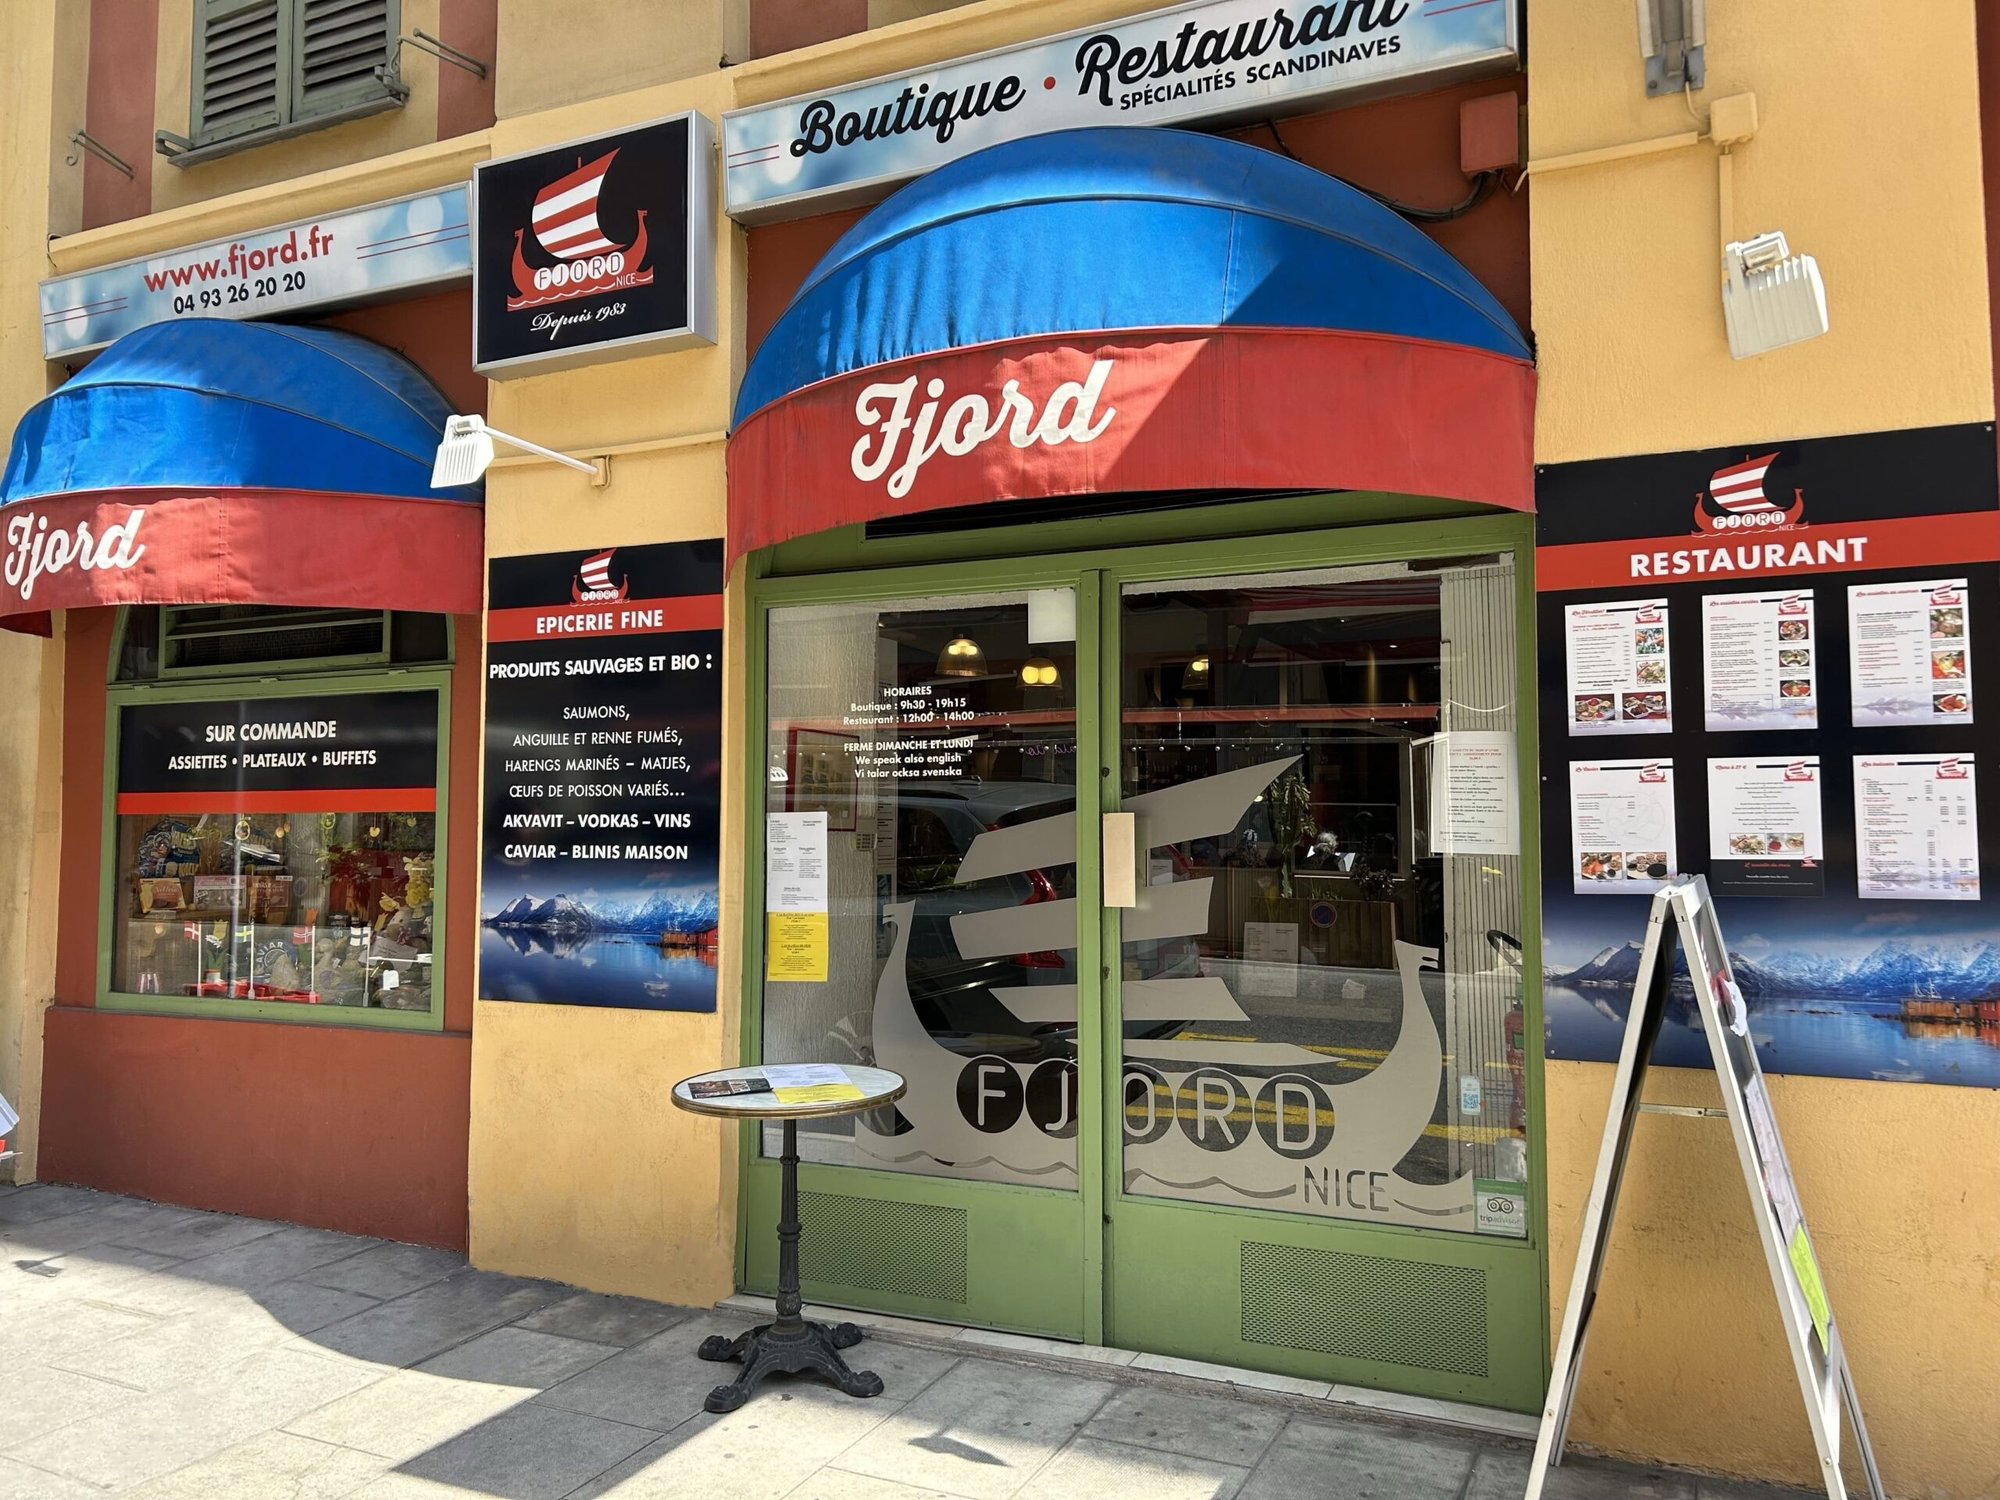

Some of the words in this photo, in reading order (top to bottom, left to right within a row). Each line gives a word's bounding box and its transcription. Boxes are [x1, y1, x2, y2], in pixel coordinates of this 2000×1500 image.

[1119, 68, 1236, 110] SPÉCIALITÉS
[1246, 35, 1401, 84] SCANDINAVES
[789, 75, 1027, 157] Boutique
[143, 224, 334, 293] www.fjord.fr
[536, 253, 623, 290] FJORD
[615, 272, 637, 287] NICE
[173, 294, 195, 315] 04
[200, 288, 222, 308] 93
[227, 283, 249, 304] 26
[254, 276, 277, 299] 20
[282, 271, 306, 292] 20
[530, 309, 593, 341] Depuis
[596, 302, 627, 321] 1983
[851, 359, 1117, 499] Fjord
[1714, 511, 1784, 529] FJORD
[4, 508, 148, 601] Fjord
[1630, 536, 1868, 578] RESTAURANT
[536, 612, 613, 634] EPICERIE
[621, 609, 664, 628] FINE
[489, 660, 560, 679] PRODUITS
[565, 656, 643, 676] SAUVAGES
[649, 655, 666, 671] ET
[671, 653, 700, 670] BIO
[883, 685, 932, 697] HORAIRES
[563, 705, 631, 721] SAUMONS,
[850, 700, 892, 714] Boutique
[900, 699, 926, 710] 9h30
[935, 697, 967, 708] 19h15
[843, 715, 893, 726] Restaurant
[903, 713, 934, 723] 12h00
[943, 711, 975, 721] 14h00
[205, 725, 235, 742] SUR
[240, 720, 337, 741] COMMANDE
[513, 733, 569, 747] ANGUILLE
[574, 732, 587, 745] ET
[591, 731, 632, 744] RENNE
[637, 726, 683, 746] FUMÉS,
[844, 742, 873, 752] FERME
[876, 740, 928, 751] DIMANCHE
[930, 739, 941, 749] ET
[943, 738, 974, 749] LUNDI
[168, 754, 227, 770] ASSIETTES
[242, 752, 307, 768] PLATEAUX
[322, 750, 377, 766] BUFFETS
[505, 759, 561, 772] HARENGS
[566, 755, 620, 771] MARINÉS
[641, 756, 691, 772] MATJES,
[855, 755, 871, 765] We
[873, 754, 901, 766] speak
[904, 753, 925, 764] also
[927, 752, 962, 766] english
[854, 769, 865, 778] Vi
[867, 768, 890, 778] talar
[892, 767, 920, 777] ocksa
[922, 766, 962, 777] svenska
[509, 784, 544, 798] ŒUFS
[549, 785, 563, 797] DE
[568, 784, 622, 797] POISSON
[502, 814, 563, 828] AKVAVIT
[577, 813, 639, 828] VODKAS
[653, 813, 691, 828] VINS
[504, 844, 556, 859] CAVIAR
[572, 845, 620, 859] BLINIS
[624, 845, 688, 860] MAISON
[970, 1060, 1322, 1155] FJORD
[1303, 1165, 1389, 1213] NICE
